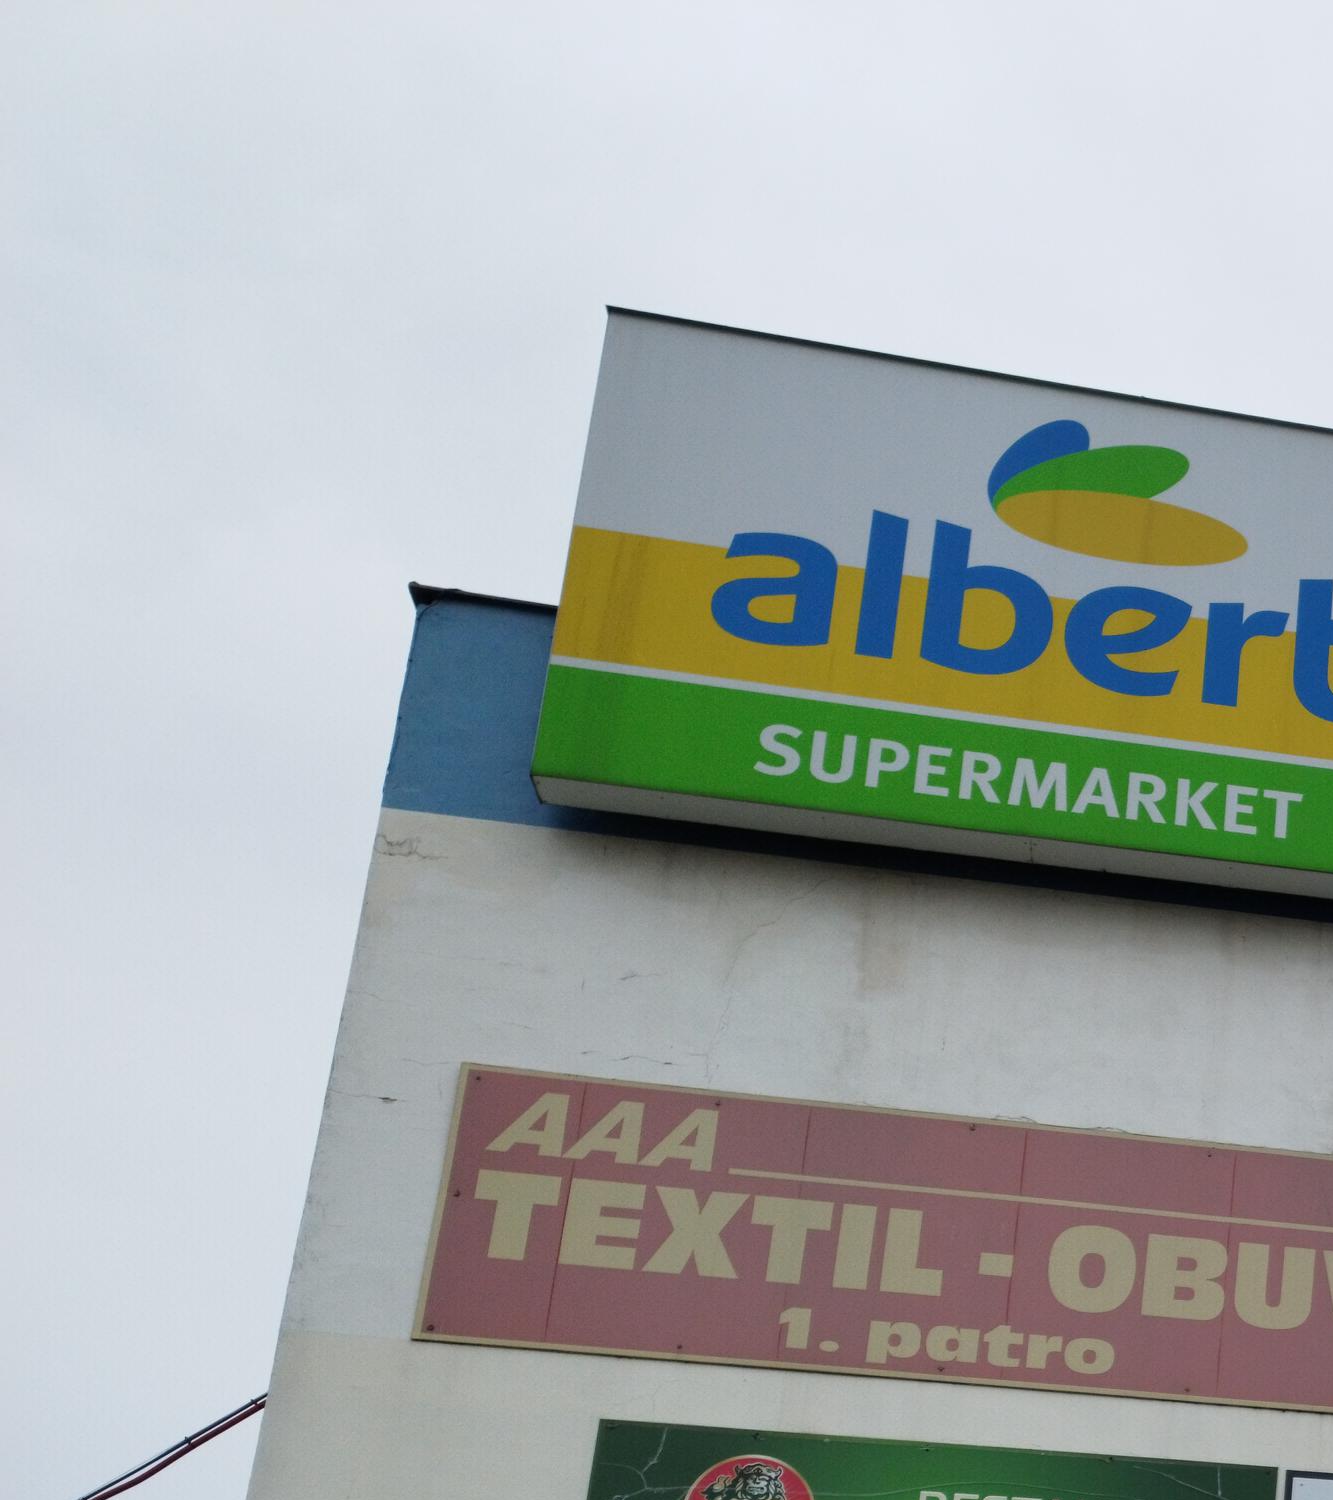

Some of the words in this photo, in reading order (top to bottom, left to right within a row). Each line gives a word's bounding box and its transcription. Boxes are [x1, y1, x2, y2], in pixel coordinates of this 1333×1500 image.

[753, 722, 1304, 840] SUPERMARKET
[485, 1092, 722, 1173] AAA
[474, 1168, 944, 1298] TEXTIL
[778, 1306, 841, 1354] 1.
[865, 1314, 1117, 1376] patro
